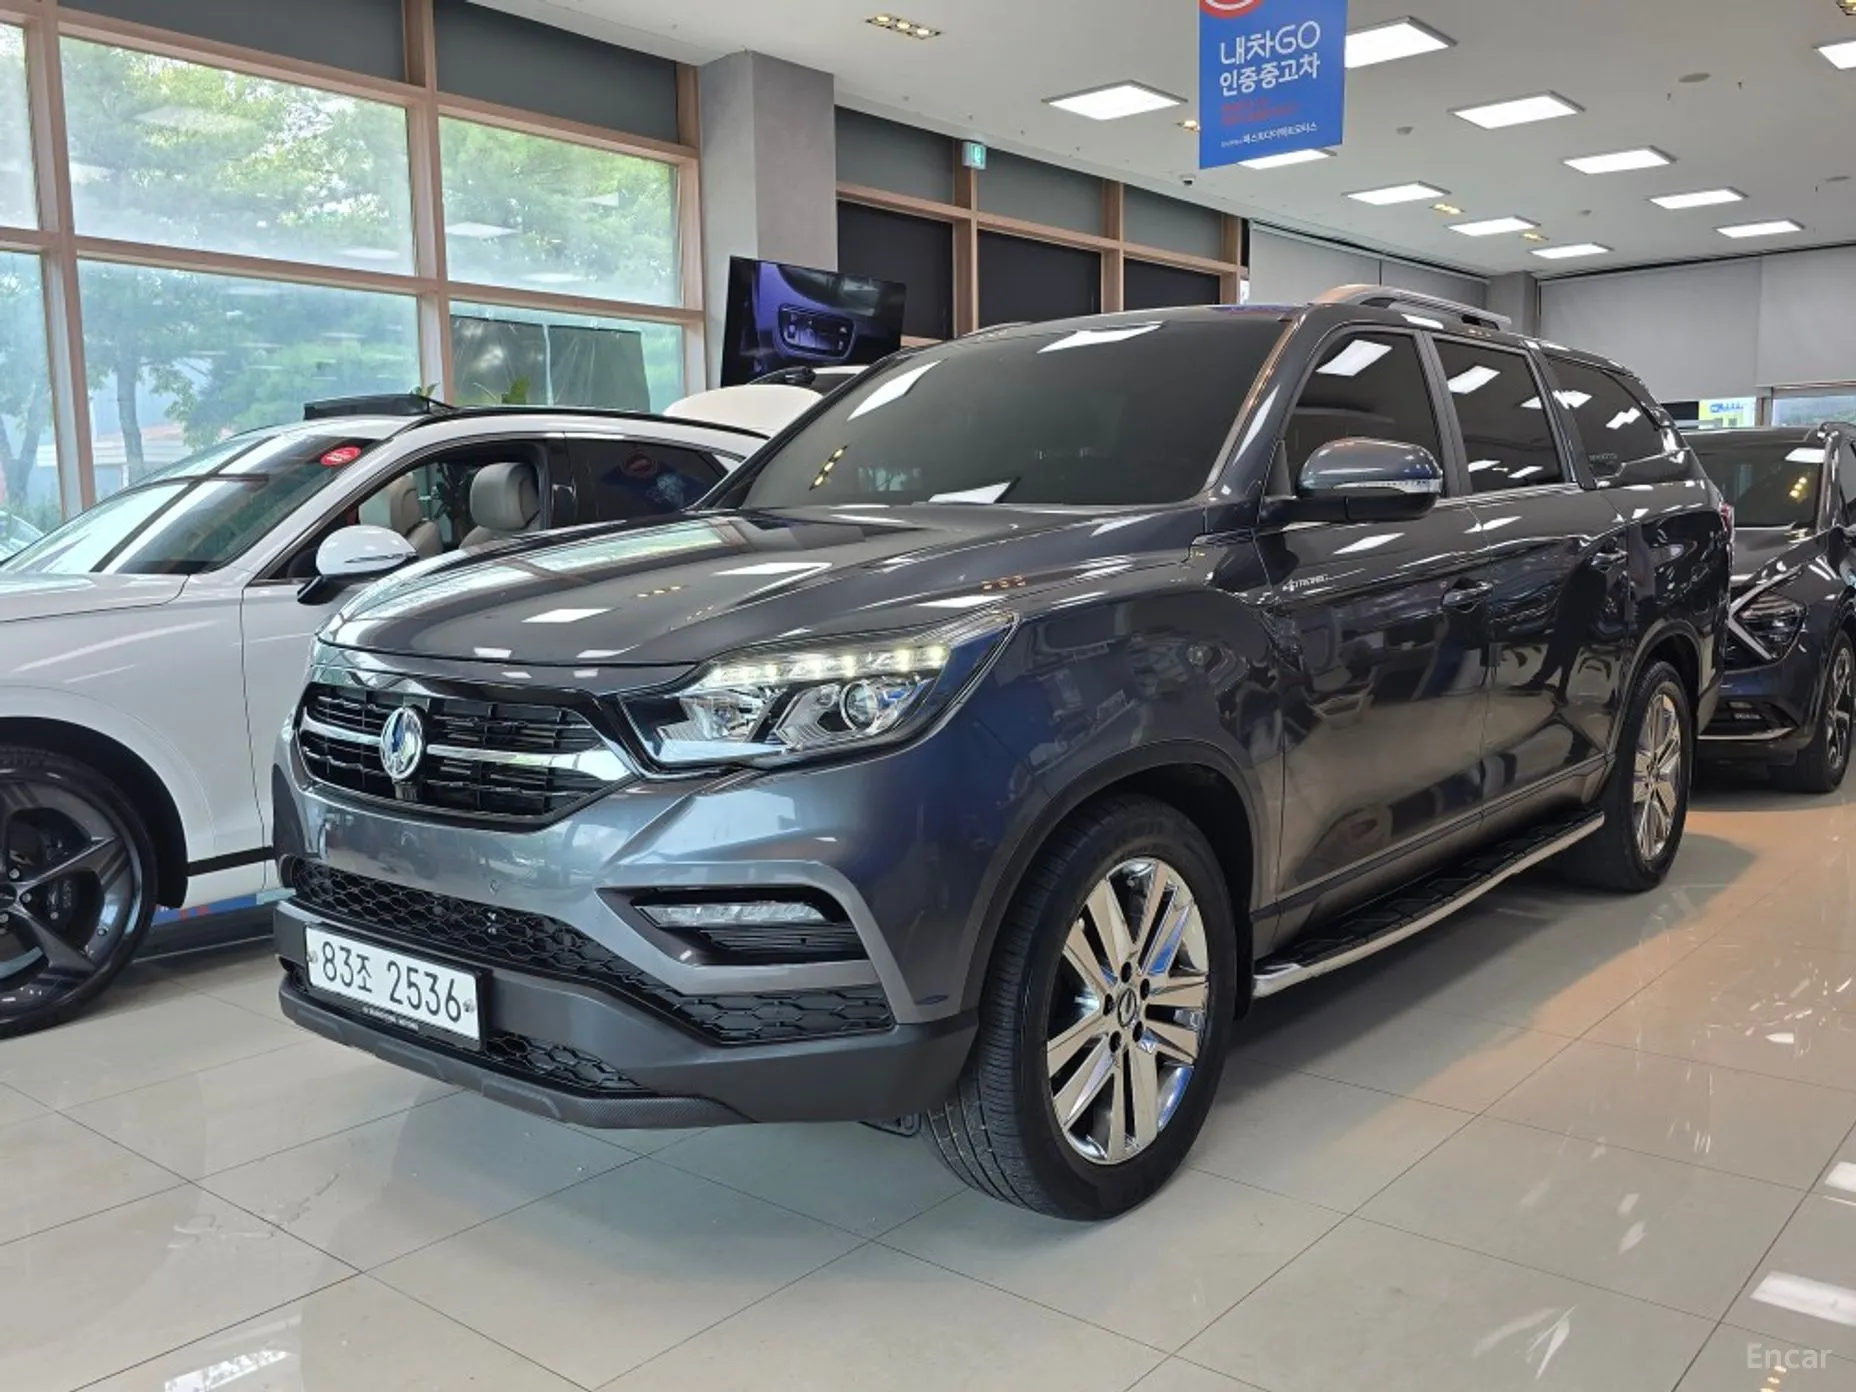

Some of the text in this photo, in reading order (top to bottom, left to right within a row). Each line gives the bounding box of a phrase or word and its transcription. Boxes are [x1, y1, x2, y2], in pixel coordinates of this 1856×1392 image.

[1220, 20, 1321, 65] 내차GO
[1219, 52, 1321, 97] 인증중고차
[322, 940, 373, 993] 83조
[387, 960, 462, 1023] 2536
